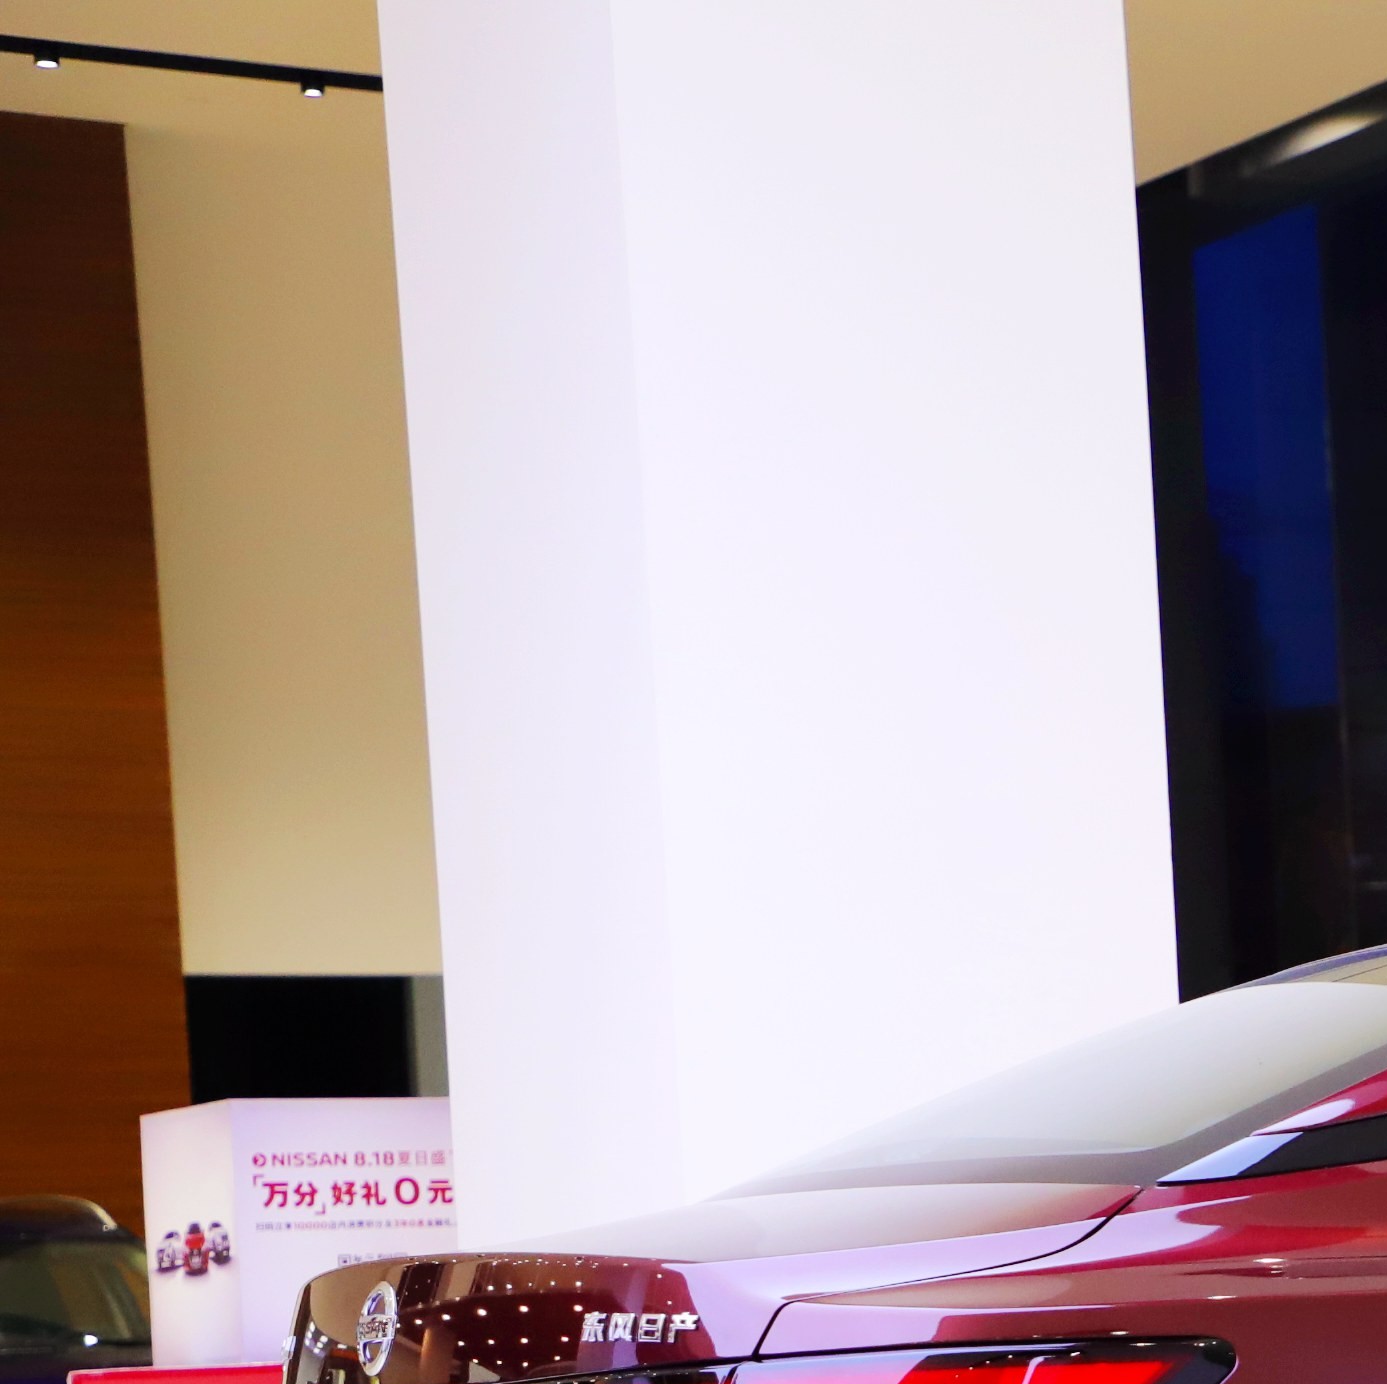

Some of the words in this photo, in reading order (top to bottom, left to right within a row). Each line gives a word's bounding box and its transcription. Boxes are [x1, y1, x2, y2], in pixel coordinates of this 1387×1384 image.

[271, 1151, 348, 1168] NISSAN
[580, 1311, 699, 1344] 东风日产
